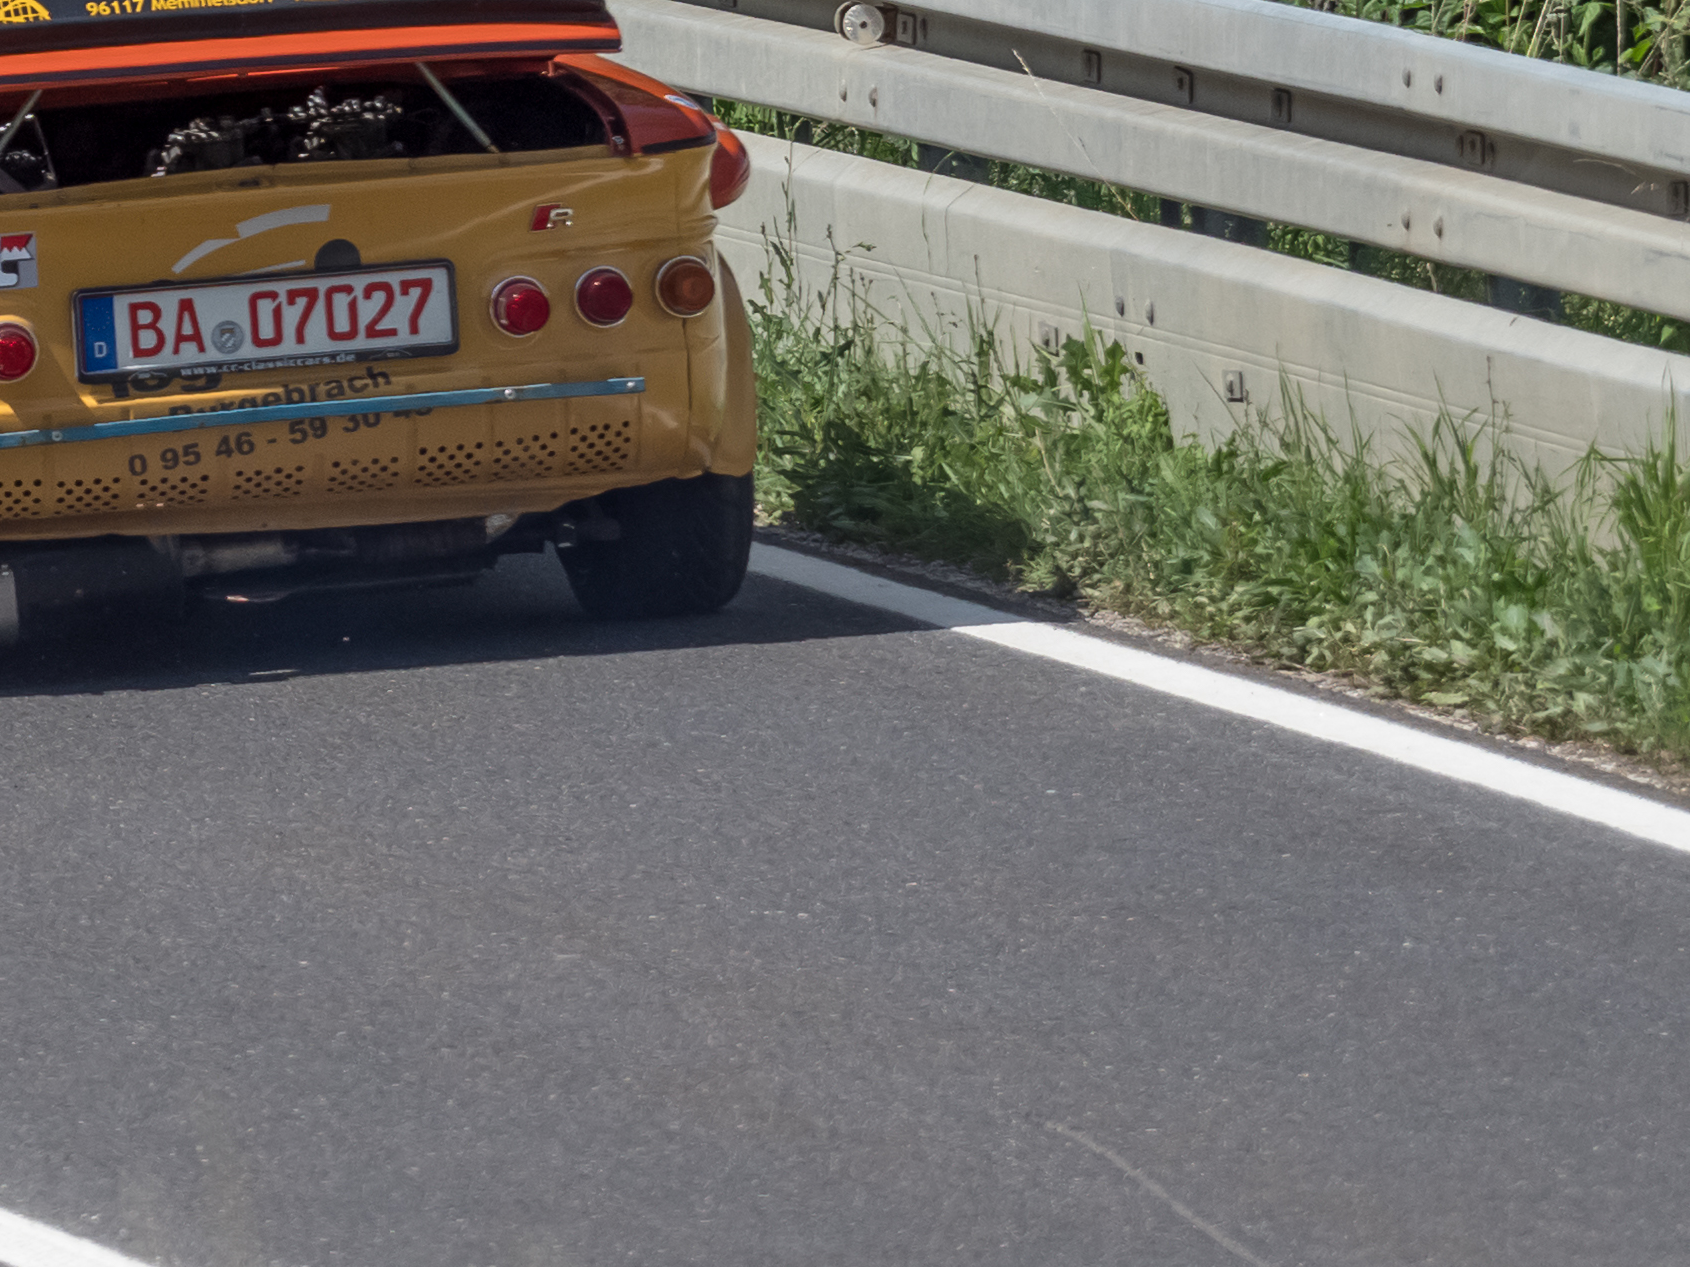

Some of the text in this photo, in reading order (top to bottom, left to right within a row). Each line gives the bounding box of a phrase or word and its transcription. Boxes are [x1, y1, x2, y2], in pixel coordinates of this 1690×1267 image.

[127, 277, 434, 359] BA 07027
[94, 341, 107, 359] D
[180, 352, 357, 377] www.cc-classiccars.de
[128, 453, 148, 477] 0
[159, 443, 202, 471] 95
[215, 431, 255, 459] 46
[288, 416, 328, 445] 59
